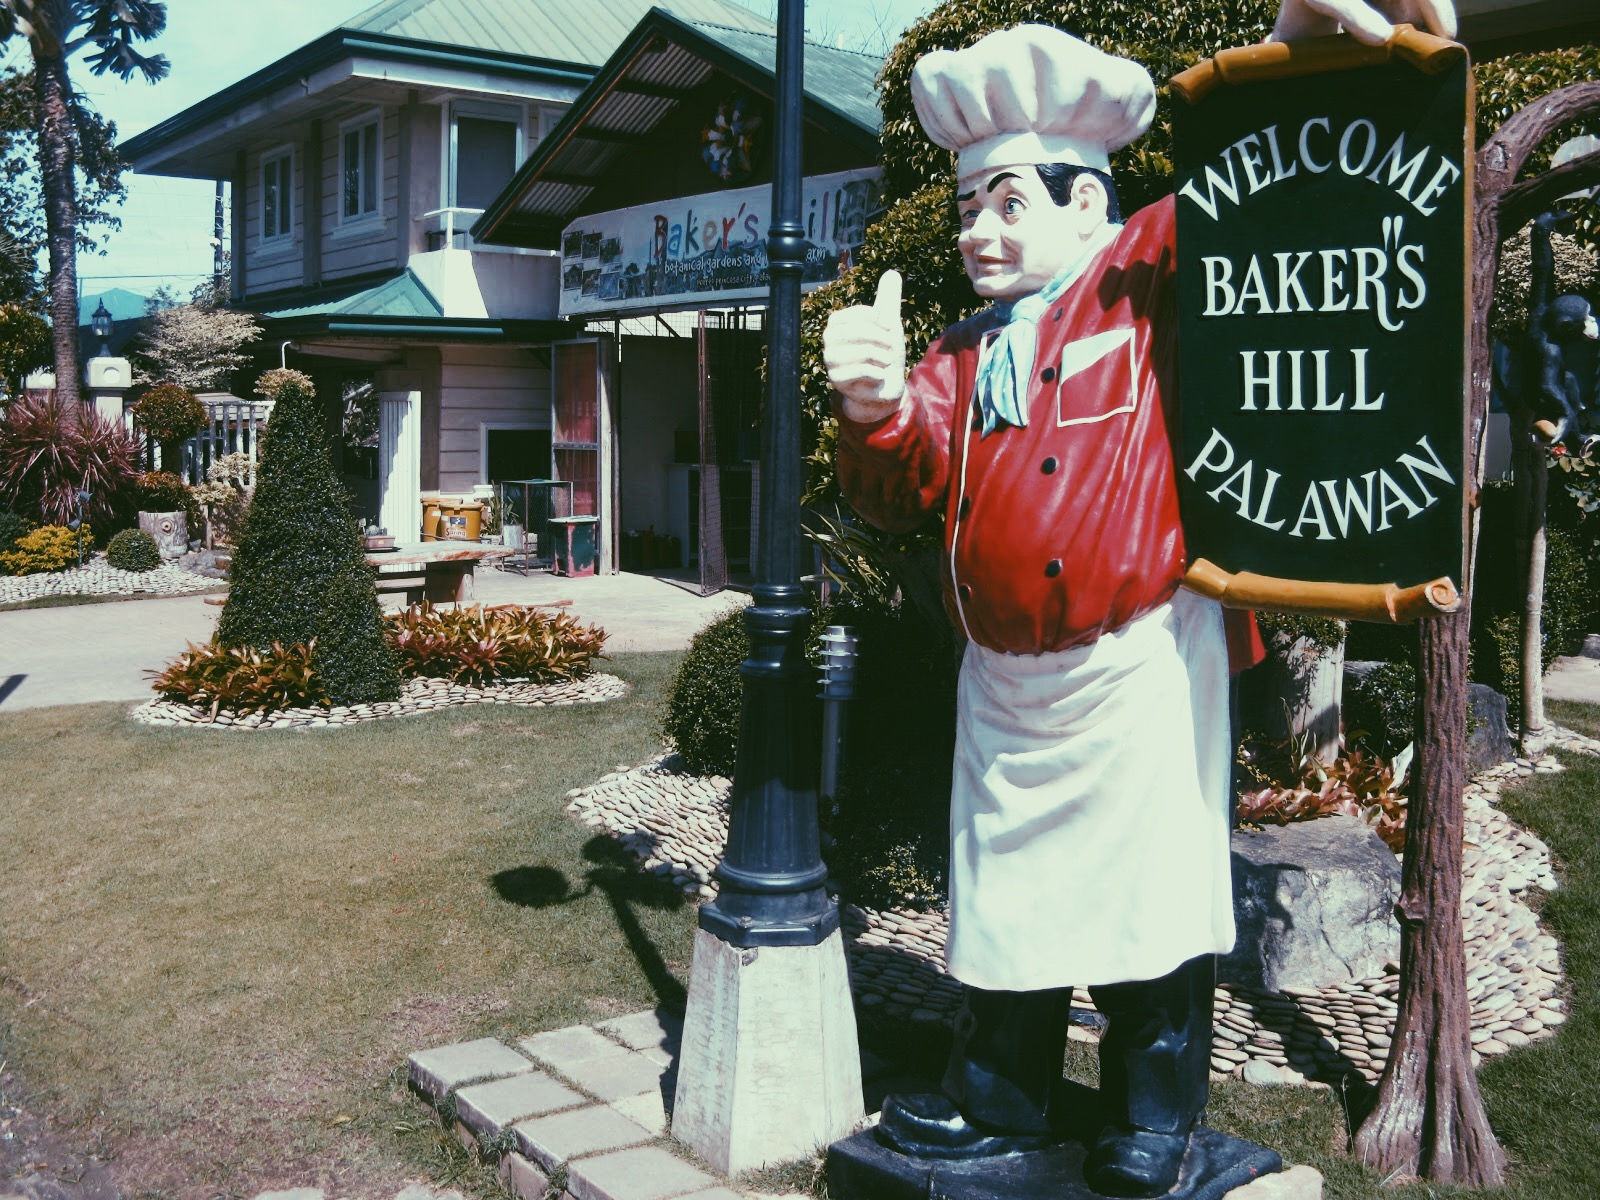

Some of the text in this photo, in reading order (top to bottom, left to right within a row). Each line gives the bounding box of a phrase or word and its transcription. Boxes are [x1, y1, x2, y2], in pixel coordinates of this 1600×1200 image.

[1178, 117, 1460, 221] WELCOME
[654, 189, 841, 259] Baker's ill
[664, 257, 704, 276] botanical
[705, 254, 742, 273] gardens
[745, 252, 762, 266] and
[806, 246, 826, 260] arm
[1239, 349, 1385, 411] HILL
[1183, 427, 1456, 541] PALAWAN
